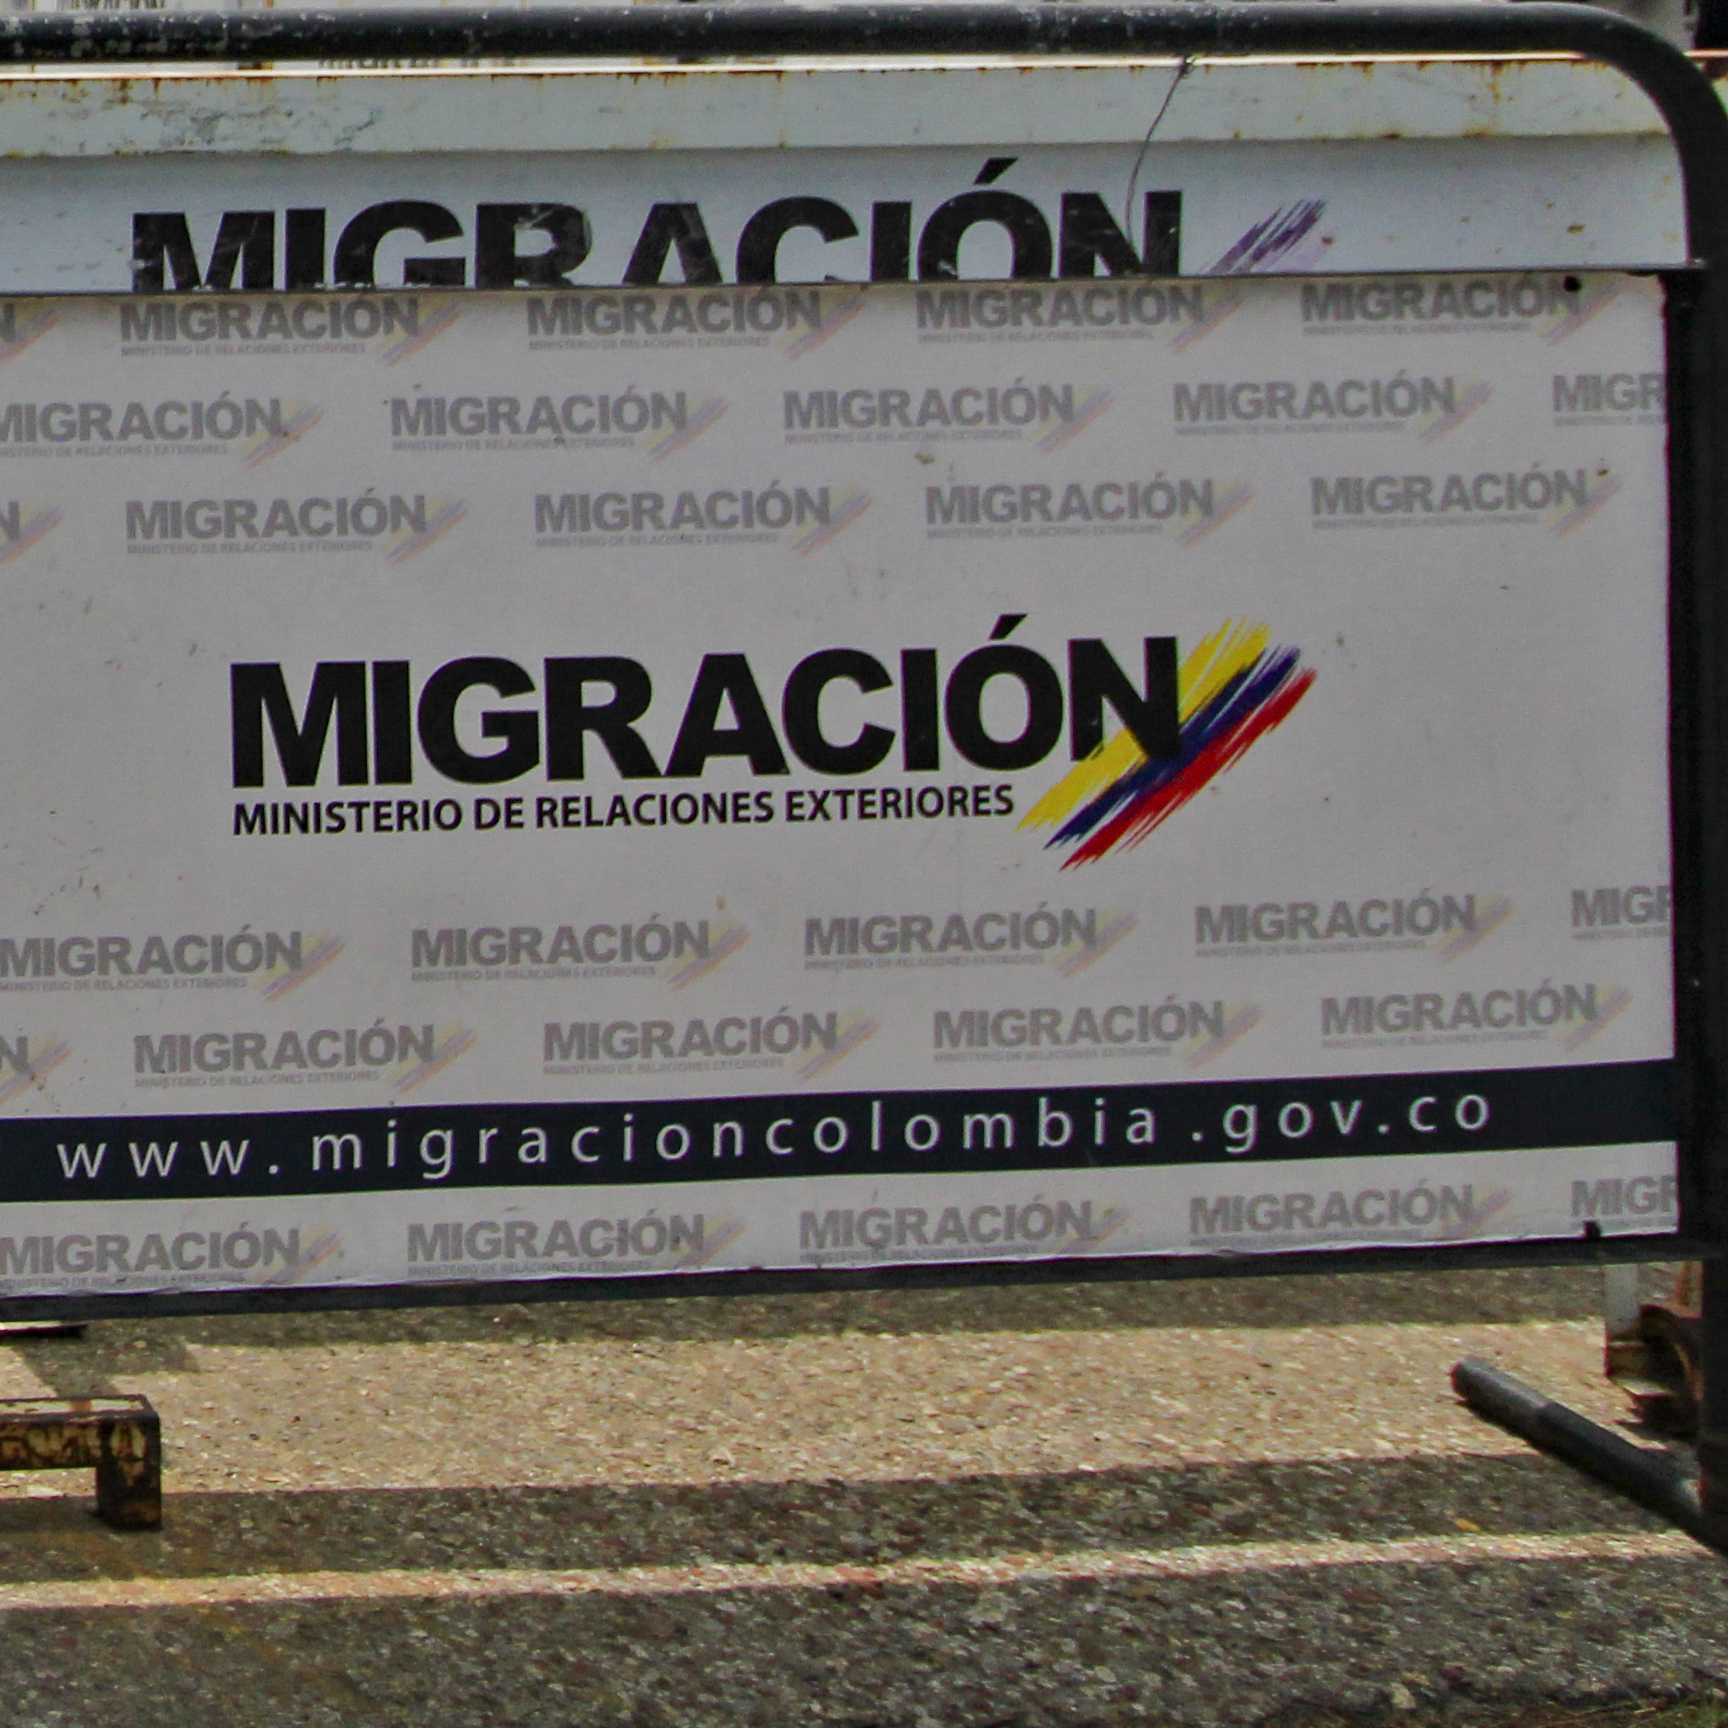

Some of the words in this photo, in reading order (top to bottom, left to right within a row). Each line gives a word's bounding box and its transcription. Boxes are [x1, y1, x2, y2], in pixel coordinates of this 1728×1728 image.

[132, 157, 1183, 291] MIGRACIÓN
[390, 385, 688, 436] MIGRACIÓN
[783, 377, 1074, 428] MIGRACIÓN
[1173, 369, 1455, 422] MIGRACIÓN
[126, 487, 426, 539] MIGRACIÓN
[535, 479, 830, 533] MIGRACIÓN
[926, 472, 1215, 525] MIGRACIÓN
[1310, 461, 1587, 516] MIGRACIÓN
[230, 613, 1181, 789] MIGRACIÓN
[232, 798, 463, 836] MINISTERIO
[474, 796, 525, 832] DE
[536, 791, 776, 829] RELACIONES
[786, 784, 1016, 824] EXTERIORES
[412, 913, 709, 968] MIGRACIÓN
[804, 901, 1096, 956] MIGRACIÓN
[1194, 888, 1476, 944] MIGRACIÓN
[544, 1006, 838, 1061] MIGRACIÓN
[933, 995, 1224, 1049] MIGRACIÓN
[1321, 978, 1597, 1036] MIGRACIÓN
[133, 1018, 435, 1073] MIGRACIÓN
[56, 1093, 1491, 1181] www.migracioncolombia.gov.co
[799, 1194, 1093, 1249] MIGRACIÓN
[1189, 1179, 1474, 1234] MIGRACIÓN
[407, 1209, 704, 1262] MIGRACIÓN
